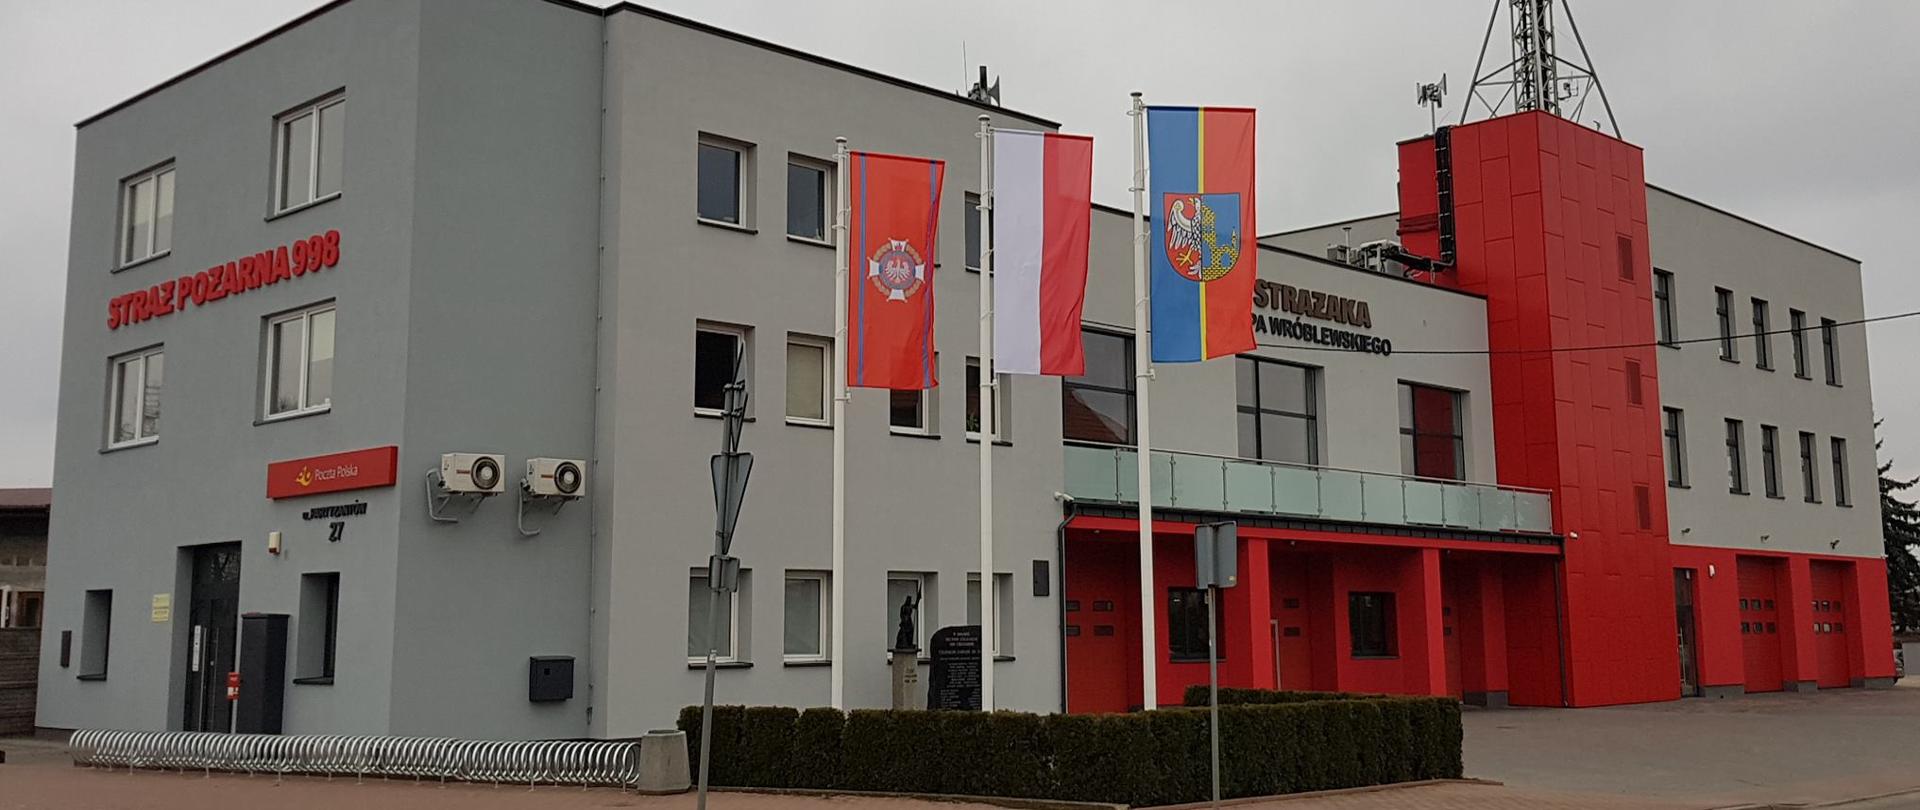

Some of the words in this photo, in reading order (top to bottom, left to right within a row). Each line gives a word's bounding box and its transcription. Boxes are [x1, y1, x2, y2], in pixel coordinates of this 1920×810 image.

[292, 229, 340, 277] 998
[1269, 316, 1391, 356] WRÓBLEWSKIEGO
[315, 468, 336, 480] Poczta
[337, 464, 358, 477] Polska
[328, 521, 345, 542] 27
